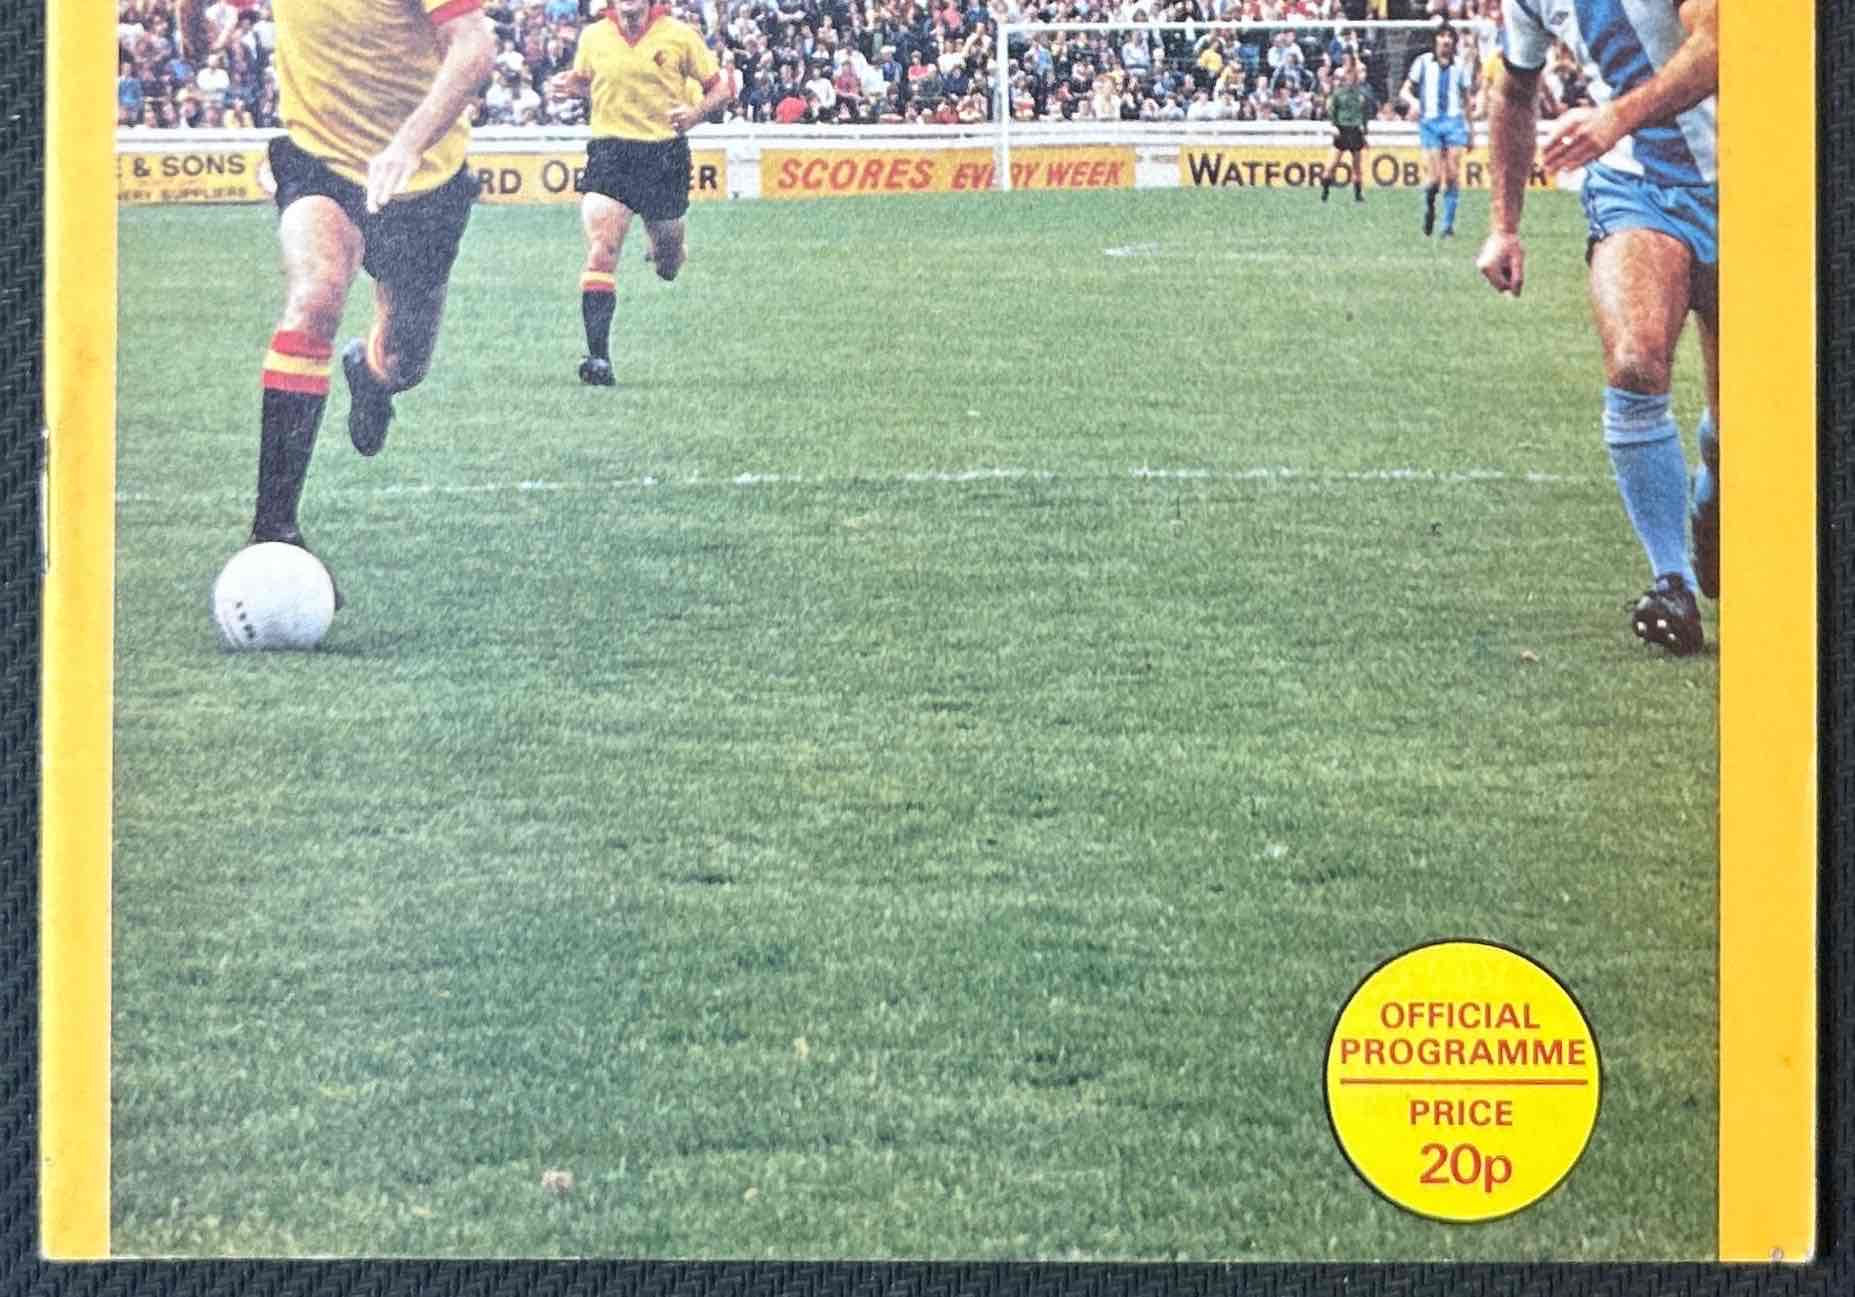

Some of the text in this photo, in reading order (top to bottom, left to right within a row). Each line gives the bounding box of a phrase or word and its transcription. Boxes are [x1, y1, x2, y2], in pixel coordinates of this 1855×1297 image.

[133, 153, 246, 178] & SONS
[777, 158, 935, 190] SCORES
[1046, 160, 1126, 188] WEEK
[1379, 1001, 1541, 1030] OFFICIAL
[1339, 1037, 1587, 1067] PROGRAMME
[1408, 1099, 1514, 1127] PRICE
[1418, 1142, 1514, 1194] 20p
